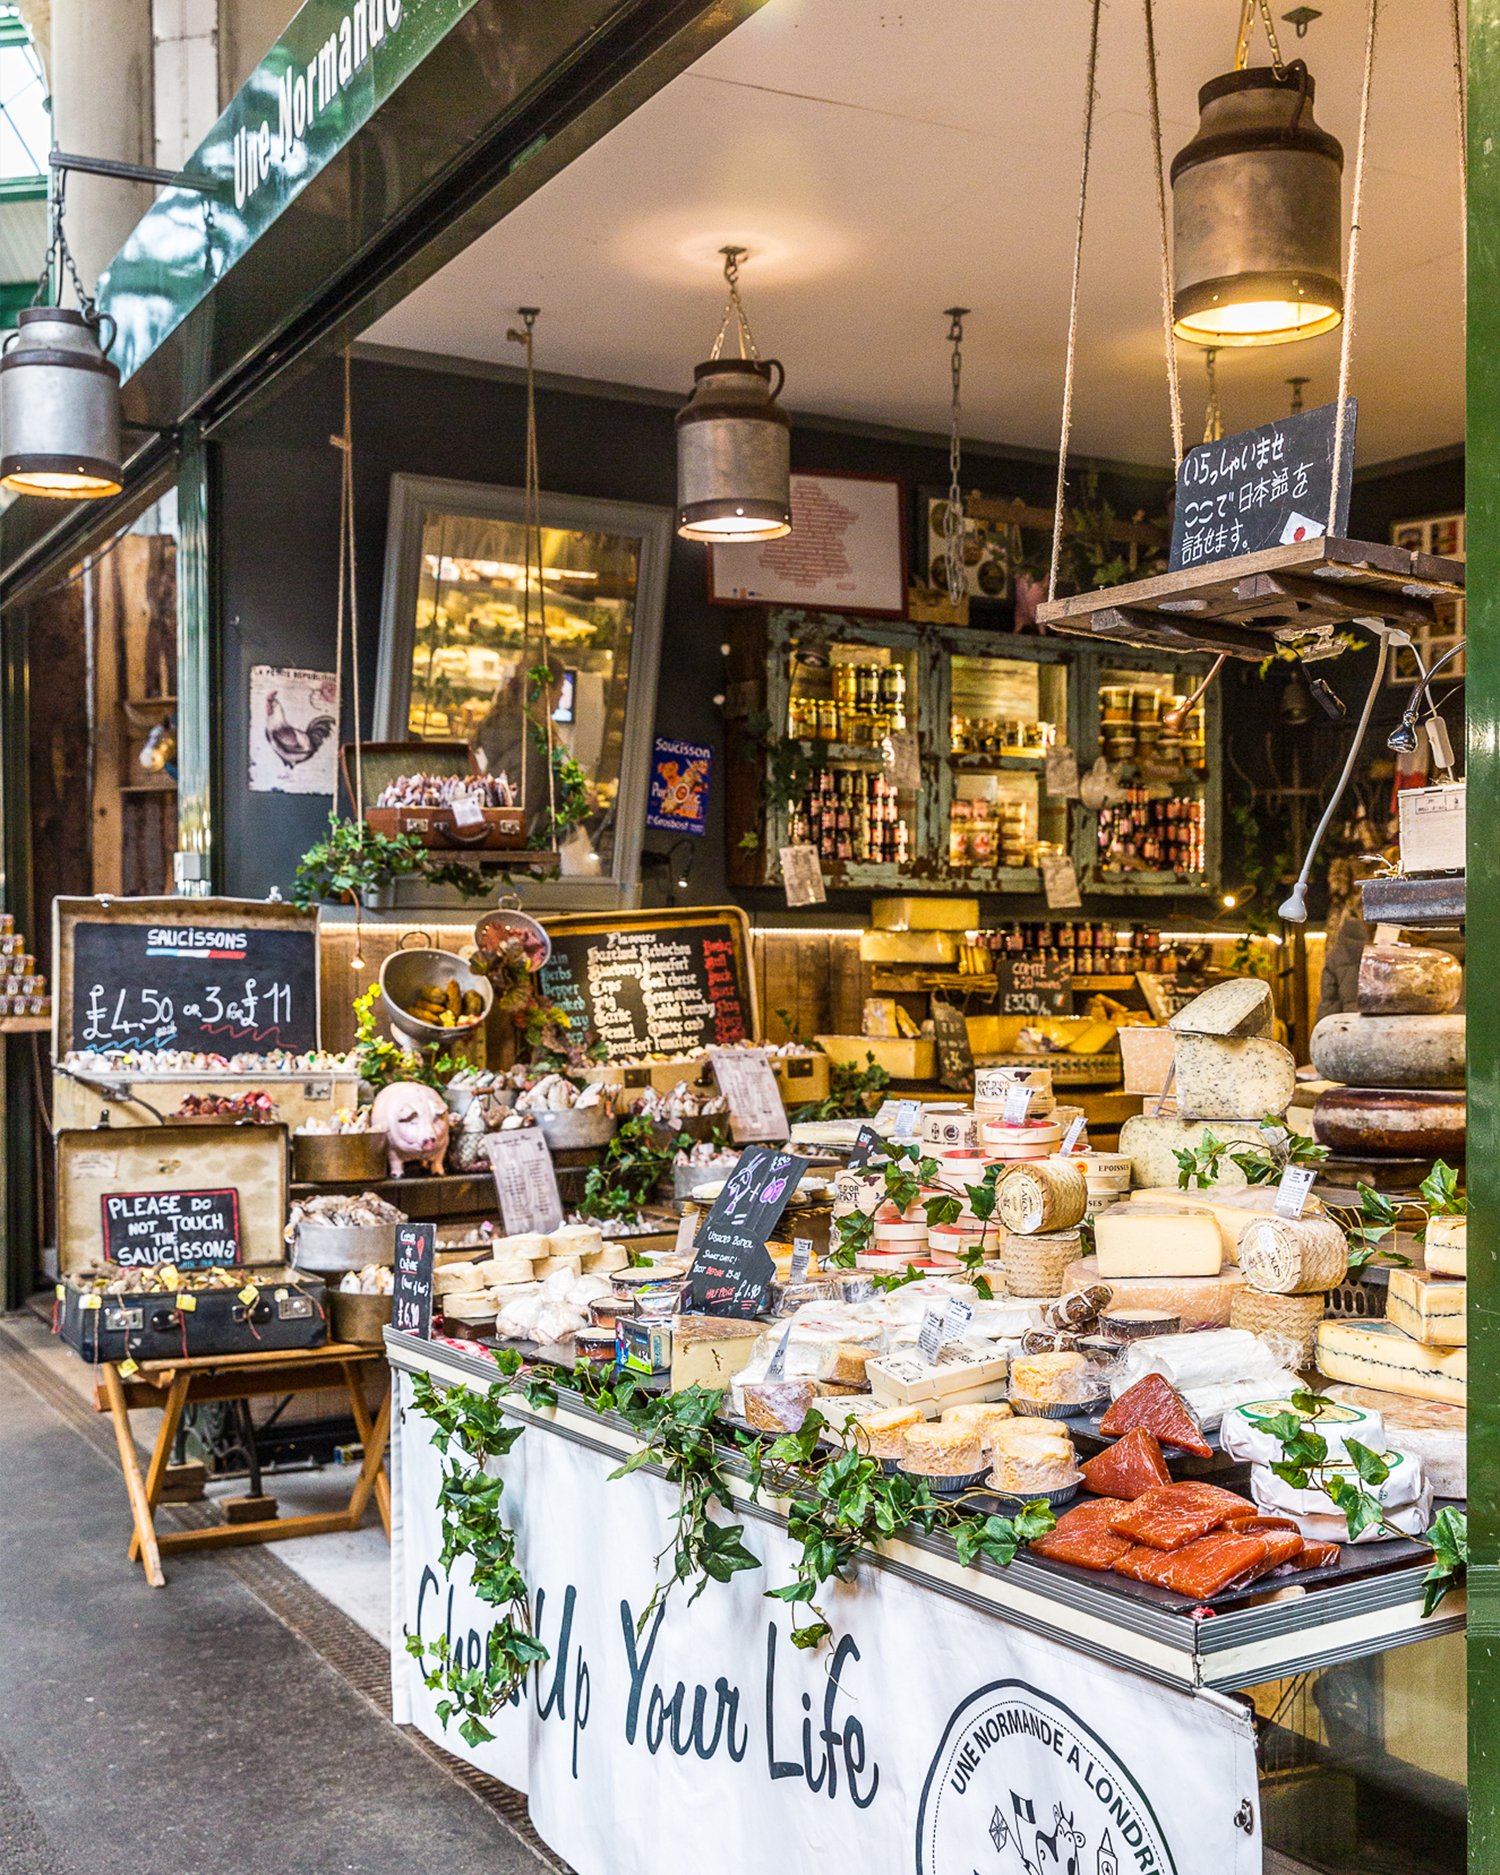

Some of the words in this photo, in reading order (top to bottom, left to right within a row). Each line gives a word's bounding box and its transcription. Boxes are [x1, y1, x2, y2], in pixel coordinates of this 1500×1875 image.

[233, 120, 271, 210] Une
[1184, 462, 1315, 528] ここで日本語を
[655, 737, 711, 759] Saucisson
[147, 928, 248, 949] SAUCISSONS
[606, 931, 656, 949] Flavours
[587, 945, 639, 965] Hazelnut
[587, 962, 643, 980] Blueberry
[668, 972, 697, 987] cheese
[589, 980, 623, 997] Ceps
[202, 986, 224, 1023] 3
[241, 978, 292, 1028] £11
[591, 994, 617, 1012] Fig
[594, 1008, 633, 1027] Garlic
[596, 1023, 636, 1041] Fennel
[107, 1195, 181, 1220] PLEASE
[191, 1198, 212, 1211] DO
[127, 1220, 159, 1236] NOT
[167, 1213, 224, 1231] TOUCH
[150, 1232, 178, 1246] THE
[117, 1240, 237, 1266] SAUCISSONS
[535, 1584, 591, 1780] Up
[620, 1594, 748, 1763] Your
[765, 1620, 880, 1809] Life
[950, 1742, 982, 1795] UNE
[972, 1708, 1065, 1757] NORMANDE
[1066, 1745, 1080, 1772] A
